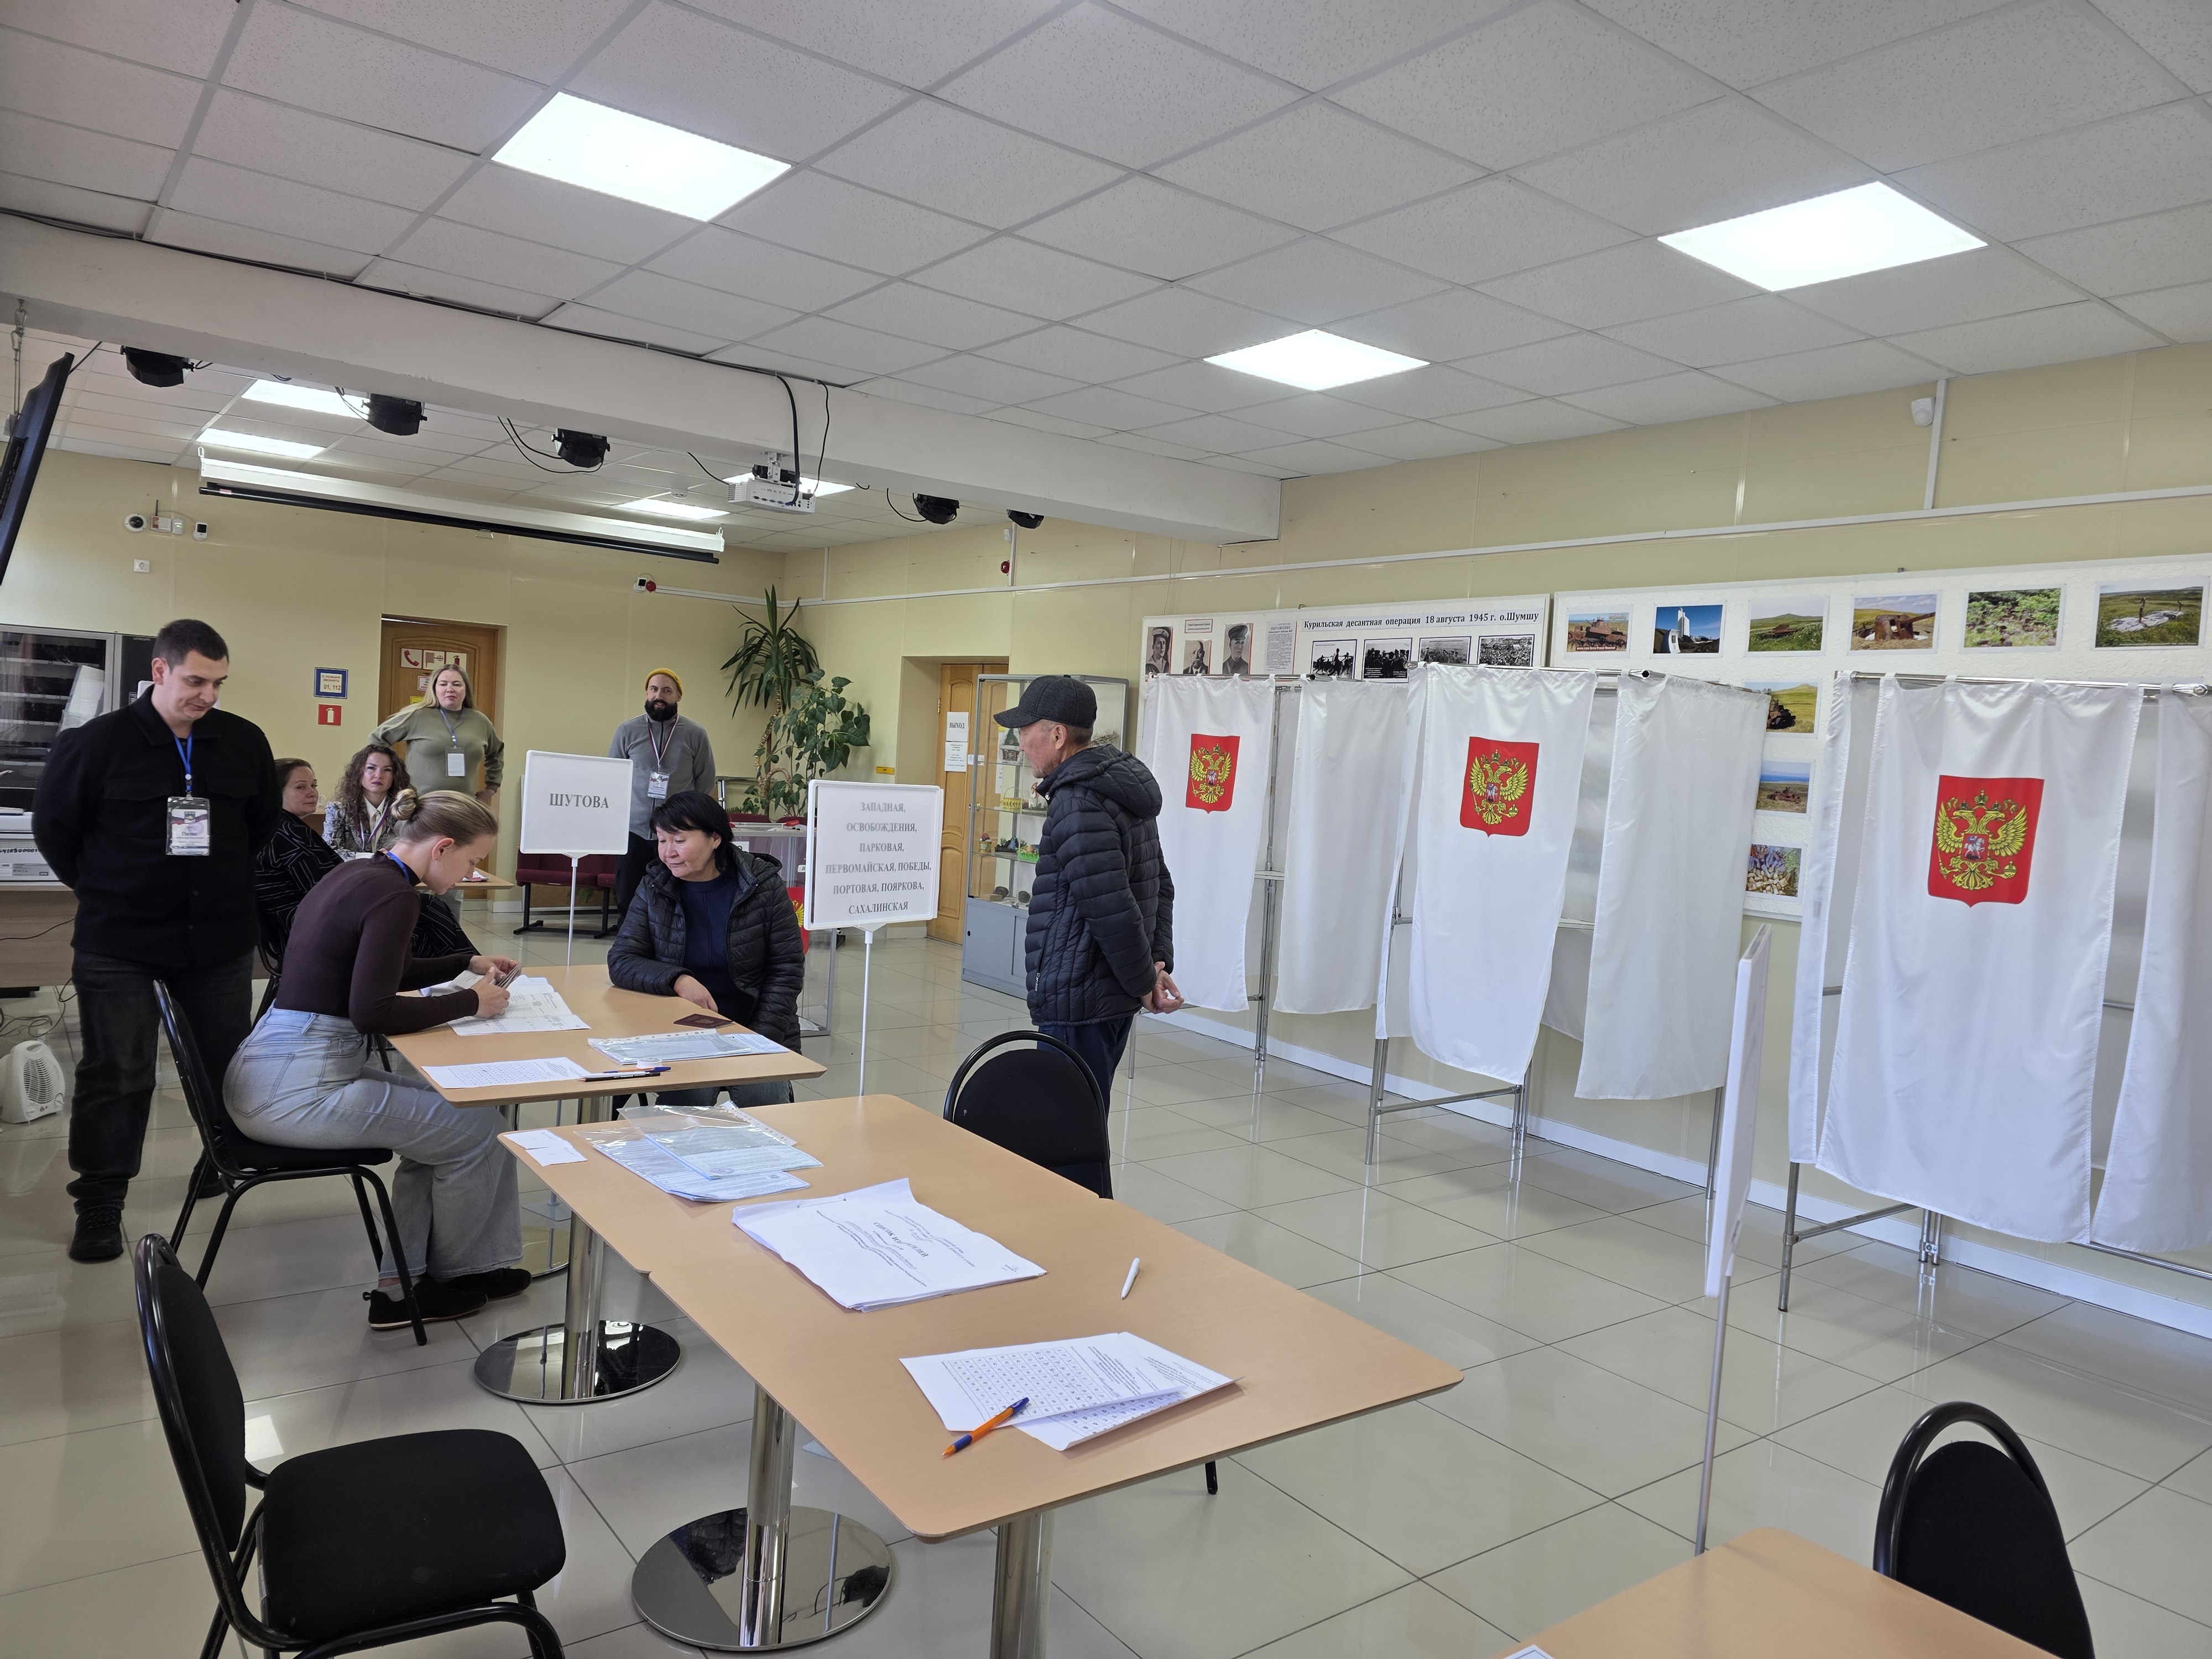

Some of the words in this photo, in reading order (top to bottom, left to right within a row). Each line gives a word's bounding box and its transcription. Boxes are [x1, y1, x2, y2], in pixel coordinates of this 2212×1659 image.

[1304, 620, 1343, 630] Курильская
[1345, 619, 1383, 628] десантная
[1385, 618, 1421, 627] операция
[1425, 615, 1434, 624] 18
[1436, 616, 1465, 625] августа
[1469, 613, 1489, 622] 1945
[549, 793, 609, 808] ШУТОВА
[860, 802, 906, 813] ЗАПАДНАЯ,
[847, 822, 917, 833] ОСВОБОЖДЕНИЯ,
[859, 842, 905, 853] ПАРКОВАЯ,
[826, 861, 896, 874] ПЕРВОМАЙСКАЯ,
[898, 861, 932, 872] ПОБЕДЫ,
[833, 883, 879, 895] ПОРТОВАЯ,
[881, 881, 925, 892] ПОЯРКОВА,
[848, 901, 909, 915] САХАЛИНСКАЯ
